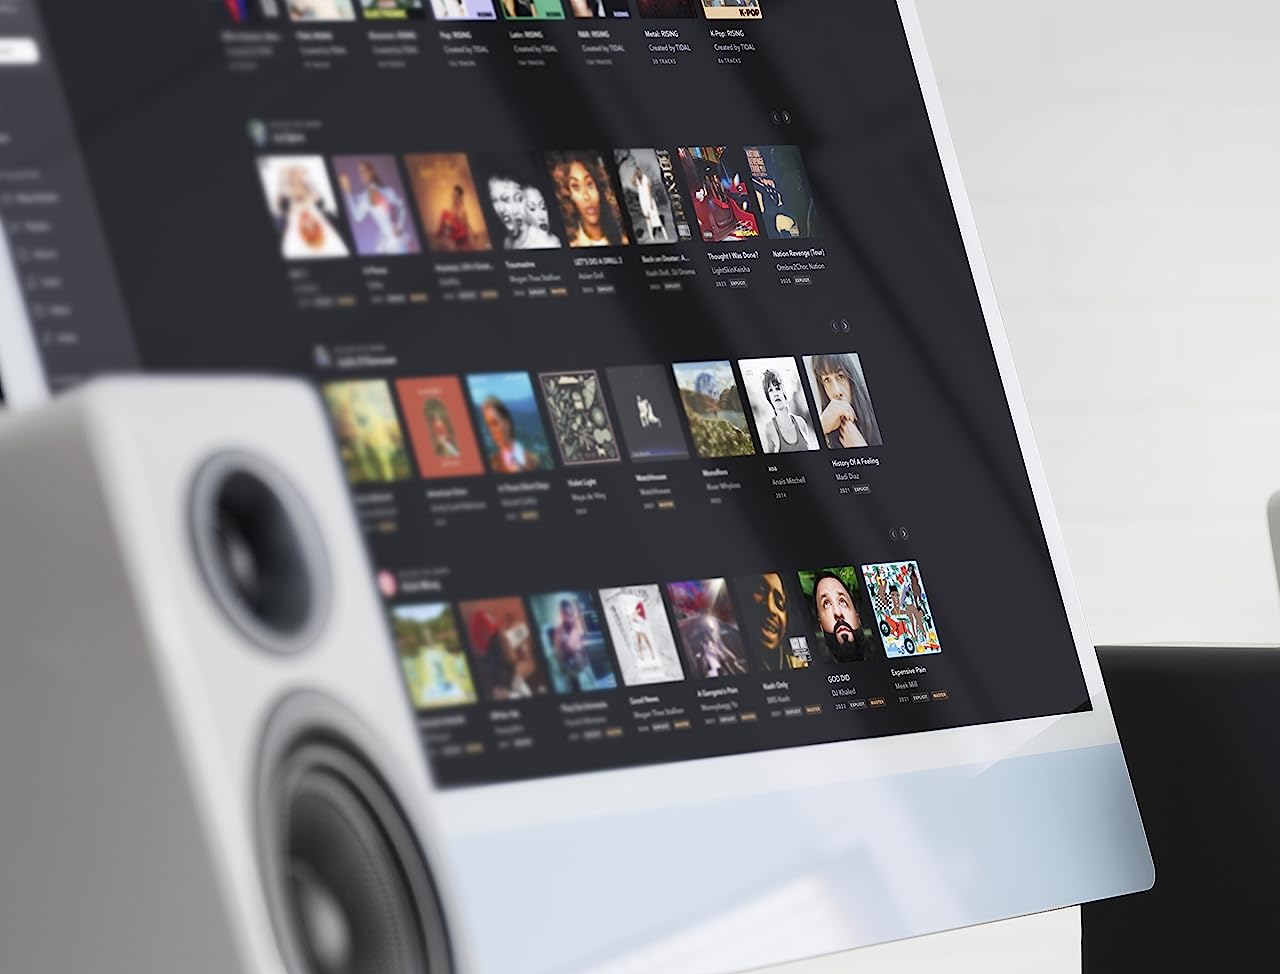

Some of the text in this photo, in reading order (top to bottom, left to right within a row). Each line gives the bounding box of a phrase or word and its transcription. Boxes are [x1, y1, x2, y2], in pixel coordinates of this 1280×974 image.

[738, 8, 760, 17] K-POP
[661, 30, 679, 38] RISING
[727, 29, 745, 37] RISING
[648, 43, 668, 51] Created
[675, 43, 692, 51] TIDAL
[713, 43, 733, 51] Created
[740, 43, 756, 51] TIDAL
[707, 251, 729, 262] Thought
[731, 251, 743, 259] Was
[742, 250, 759, 259] Done?
[772, 248, 826, 258] Nation Revenge (Tour)
[831, 459, 849, 468] History
[861, 457, 880, 466] Feeling
[890, 666, 927, 678] Expensive Pain
[827, 674, 851, 683] GOD DID
[894, 680, 918, 690] Meek Mill
[831, 687, 857, 697] DJ Khaled
